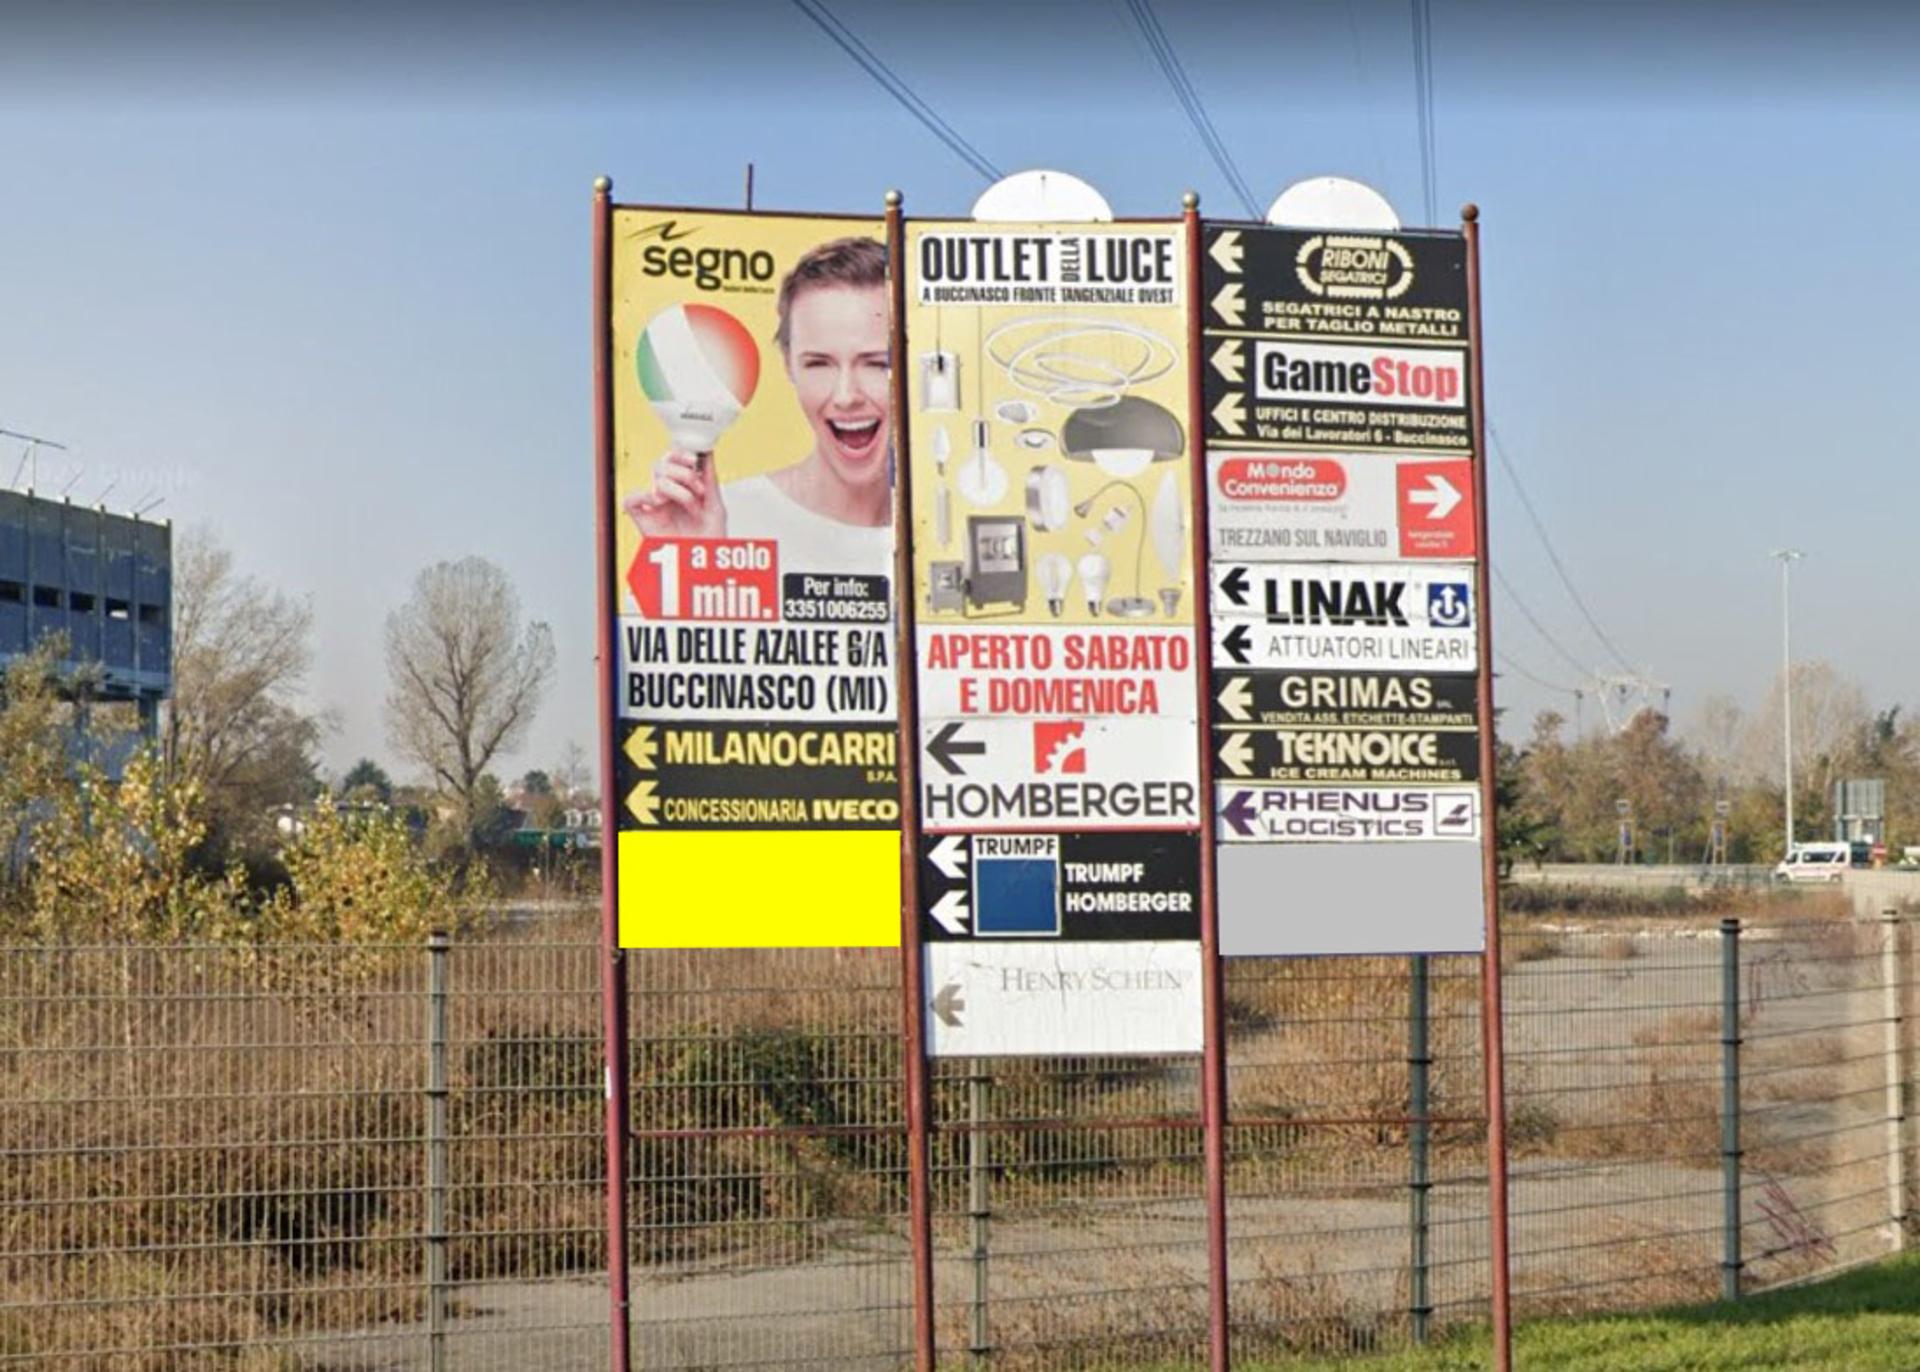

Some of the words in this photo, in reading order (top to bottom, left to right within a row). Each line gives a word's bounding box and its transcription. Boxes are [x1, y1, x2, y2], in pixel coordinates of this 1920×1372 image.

[642, 245, 775, 291] segno
[921, 237, 1053, 282] OUTLET
[1061, 237, 1081, 282] DELLA
[1086, 238, 1173, 283] LUCE
[1321, 249, 1389, 270] RIBONI
[1319, 270, 1387, 285] SEGATRICI
[923, 288, 931, 301] A
[934, 287, 1009, 302] BUCCINASCO
[1013, 287, 1056, 303] FRONTE
[1061, 287, 1134, 303] TANGENZIALE
[1139, 288, 1174, 304] OVEST
[1262, 300, 1361, 318] SEGATRICI
[1367, 306, 1380, 318] A
[1385, 305, 1461, 322] NASTRO
[1264, 316, 1300, 330] PER
[1306, 318, 1374, 334] TAGLIO
[1379, 322, 1458, 336] METALLI
[1263, 350, 1459, 401] GameStop
[1256, 406, 1298, 421] UFFICI
[1302, 409, 1310, 423] E
[1313, 409, 1366, 425] CENTRO
[1369, 411, 1467, 430] DISTRIBUZIONE
[1256, 424, 1279, 438] Via
[1305, 426, 1372, 443] Lavoratori
[1394, 430, 1469, 447] Buccinasco
[1224, 479, 1339, 498] Convenienza
[1219, 528, 1291, 548] TREZZANO
[1294, 529, 1321, 548] SUL
[1323, 529, 1388, 549] NAVIGLIO
[691, 546, 708, 569] a
[716, 543, 771, 570] solo
[649, 543, 681, 618] 1
[803, 576, 829, 598] Per
[833, 577, 869, 598] info:
[691, 578, 773, 619] min.
[784, 599, 888, 620] 3351006255
[1264, 578, 1410, 628] LINAK
[627, 626, 669, 664] VIA
[677, 627, 746, 665] DELLE
[754, 629, 839, 667] AZALEE
[848, 630, 889, 668] 6/A
[926, 633, 1053, 670] APERTO
[1063, 634, 1190, 671] SABATO
[1267, 634, 1383, 658] ATTUATORI
[1390, 638, 1469, 660] LINEARI
[627, 671, 816, 711] BUCCINASCO
[826, 675, 889, 714] (MI)
[959, 677, 978, 714] E
[988, 677, 1159, 715] DOMENICA
[1280, 675, 1433, 708] GRIMAS
[664, 730, 896, 766] MILANOCARRI
[1276, 731, 1438, 765] TEKNOICE
[1270, 767, 1301, 779] ICE
[1304, 767, 1367, 780] CREAM
[1370, 768, 1462, 781] MACHINES
[663, 798, 809, 822] CONCESSIONARIA
[812, 799, 899, 822] IVECO
[925, 781, 1196, 818] HOMBERGER
[1261, 790, 1429, 813] RHENUS
[1269, 818, 1425, 837] LOGISTICS
[975, 838, 1057, 856] TRUMPF
[1065, 863, 1144, 884] TRUMPF
[1065, 892, 1193, 912] HOMBERGER
[1001, 966, 1087, 991] HENRY
[1090, 966, 1183, 991] SCHEIN
